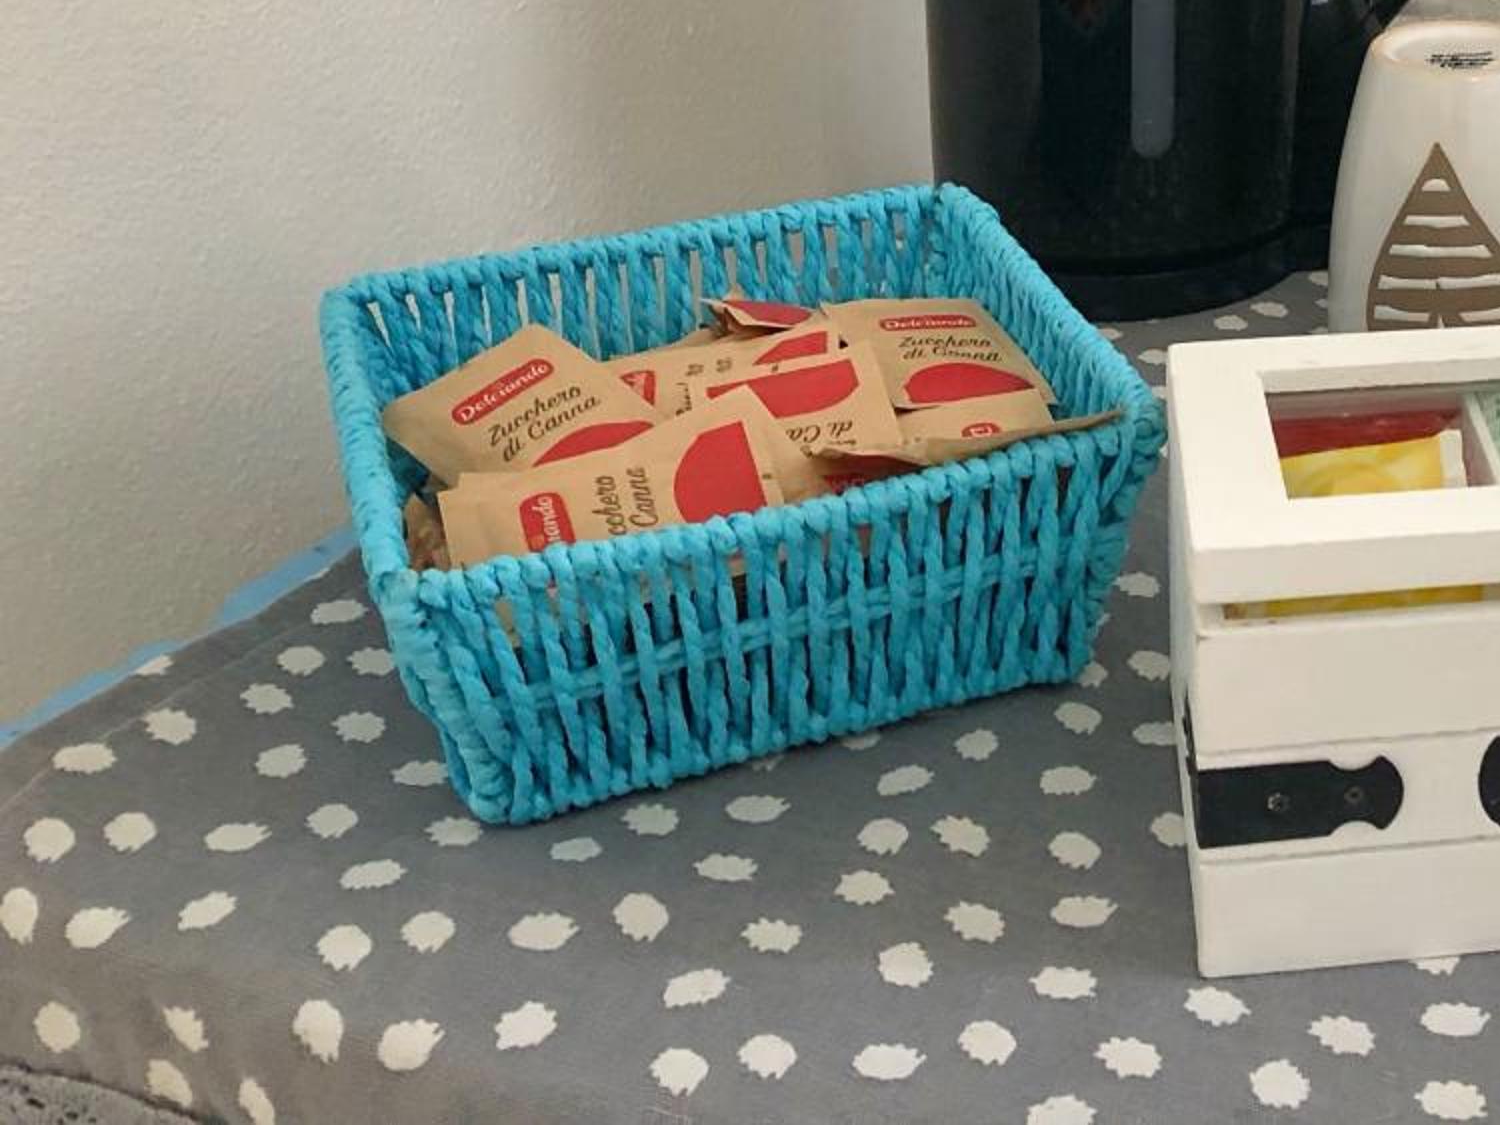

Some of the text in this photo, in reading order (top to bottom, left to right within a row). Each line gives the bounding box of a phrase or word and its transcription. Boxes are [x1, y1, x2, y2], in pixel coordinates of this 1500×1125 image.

[487, 384, 583, 447] Zucchero
[502, 395, 602, 464] di Canna
[532, 495, 561, 544] iando
[592, 474, 627, 536] cchero
